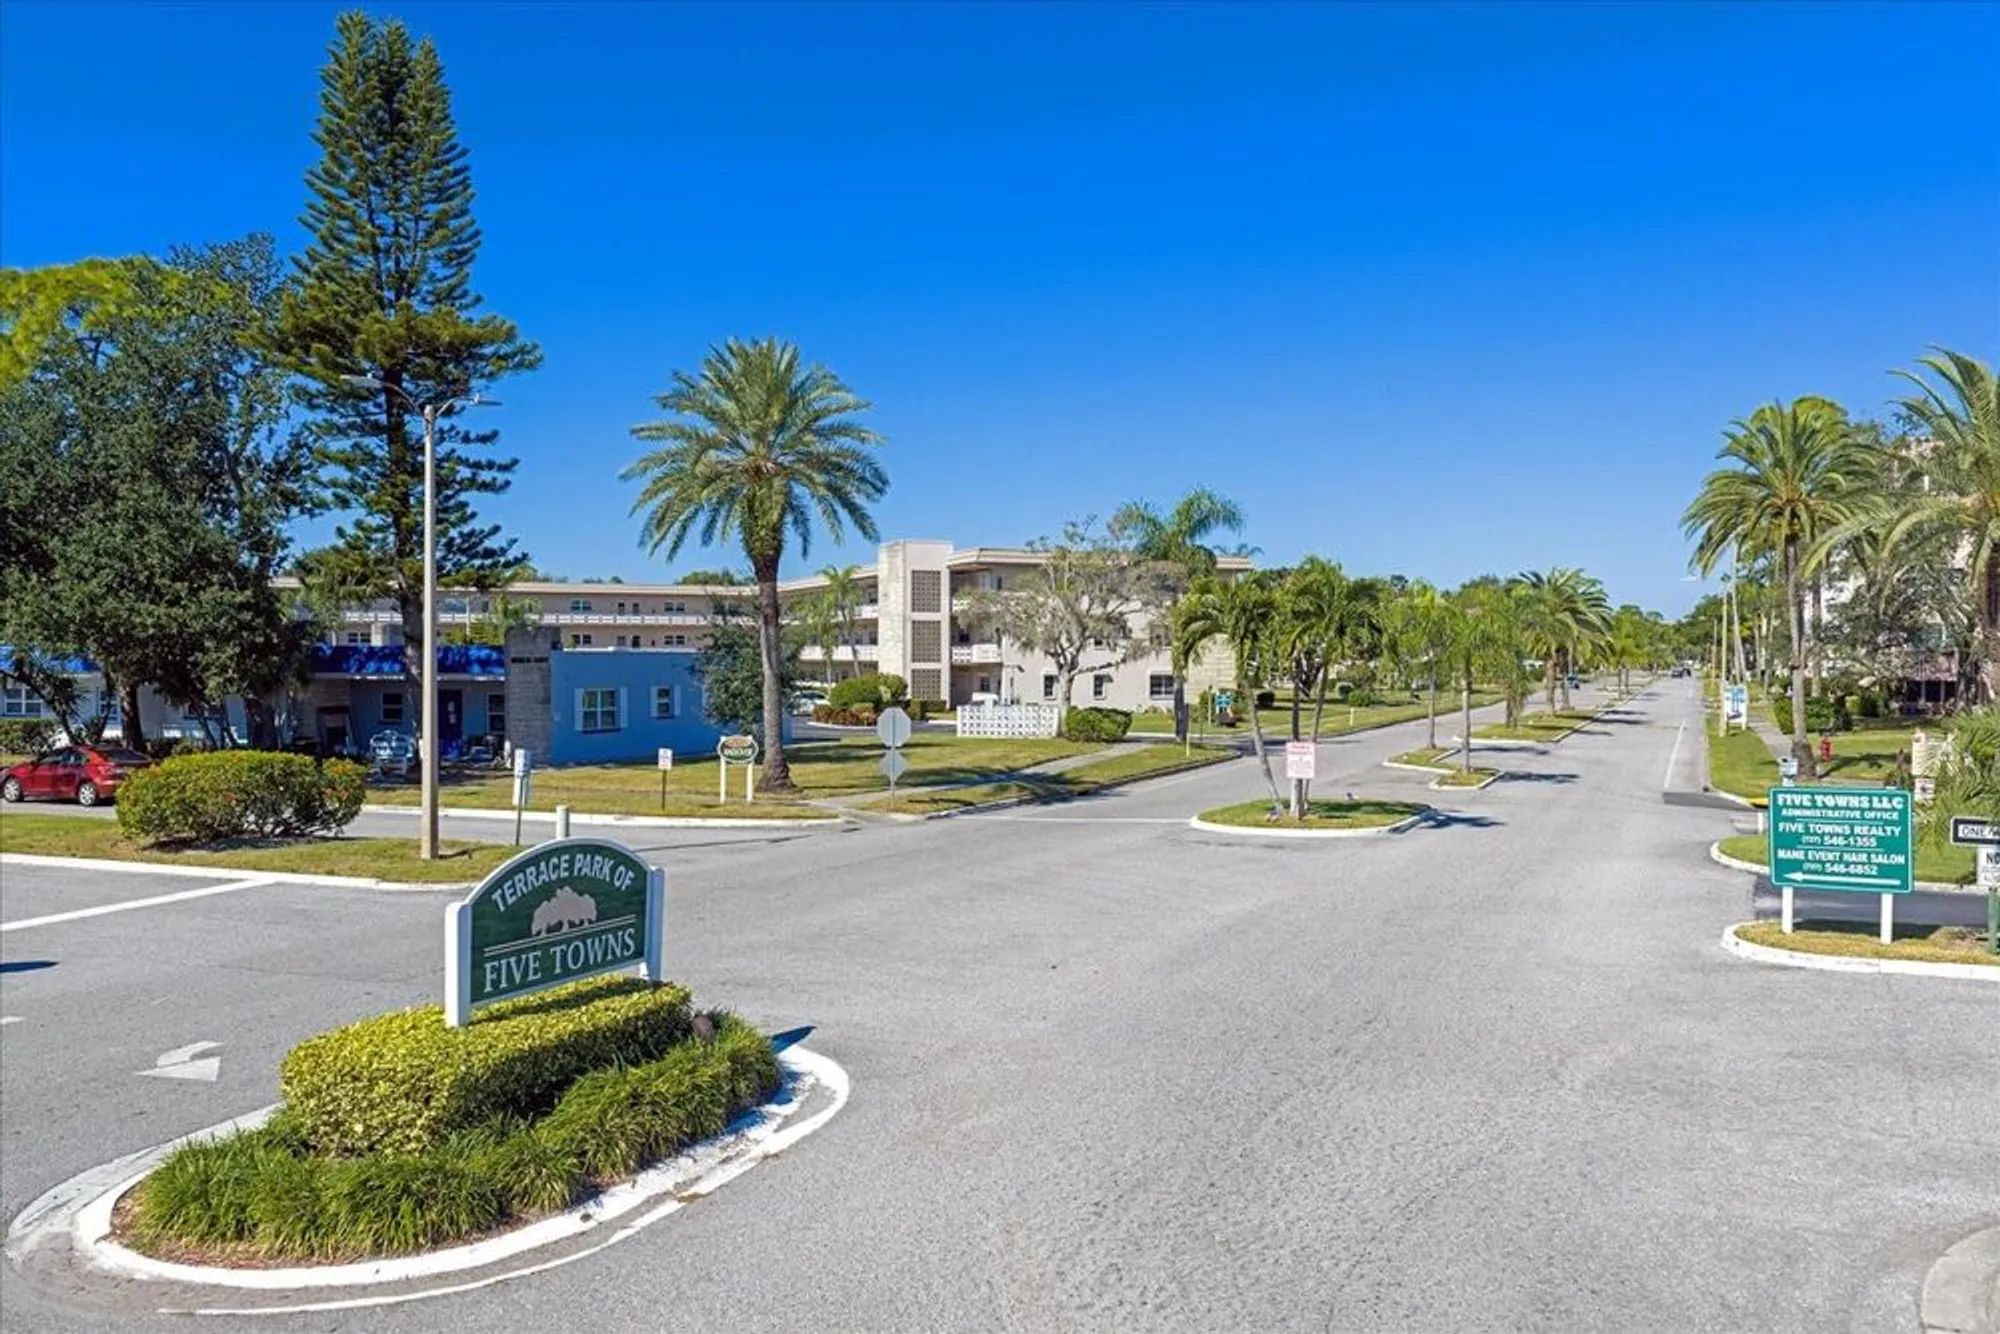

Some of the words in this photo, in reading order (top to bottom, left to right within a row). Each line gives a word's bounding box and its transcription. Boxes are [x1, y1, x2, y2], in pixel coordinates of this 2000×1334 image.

[1777, 793, 1812, 806] FIVE
[1814, 795, 1870, 808] TOWNS
[1872, 796, 1904, 809] LLC
[1781, 808, 1861, 819] ADMINISTRATIVE
[1864, 811, 1899, 820] OFFICE
[1778, 822, 1805, 833] FIVE
[1808, 824, 1851, 835] TOWNS
[1854, 825, 1901, 837] REALTY
[1961, 826, 1987, 838] ONE
[1777, 849, 1805, 859] MANE
[1808, 850, 1840, 861] EVENT
[1842, 851, 1868, 863] HAIR
[1870, 853, 1905, 864] SALON
[491, 854, 571, 912] TERRACE
[574, 853, 614, 882] PARK
[614, 865, 635, 891] OF
[483, 951, 542, 993] FIVE
[550, 928, 635, 974] TOWNS
